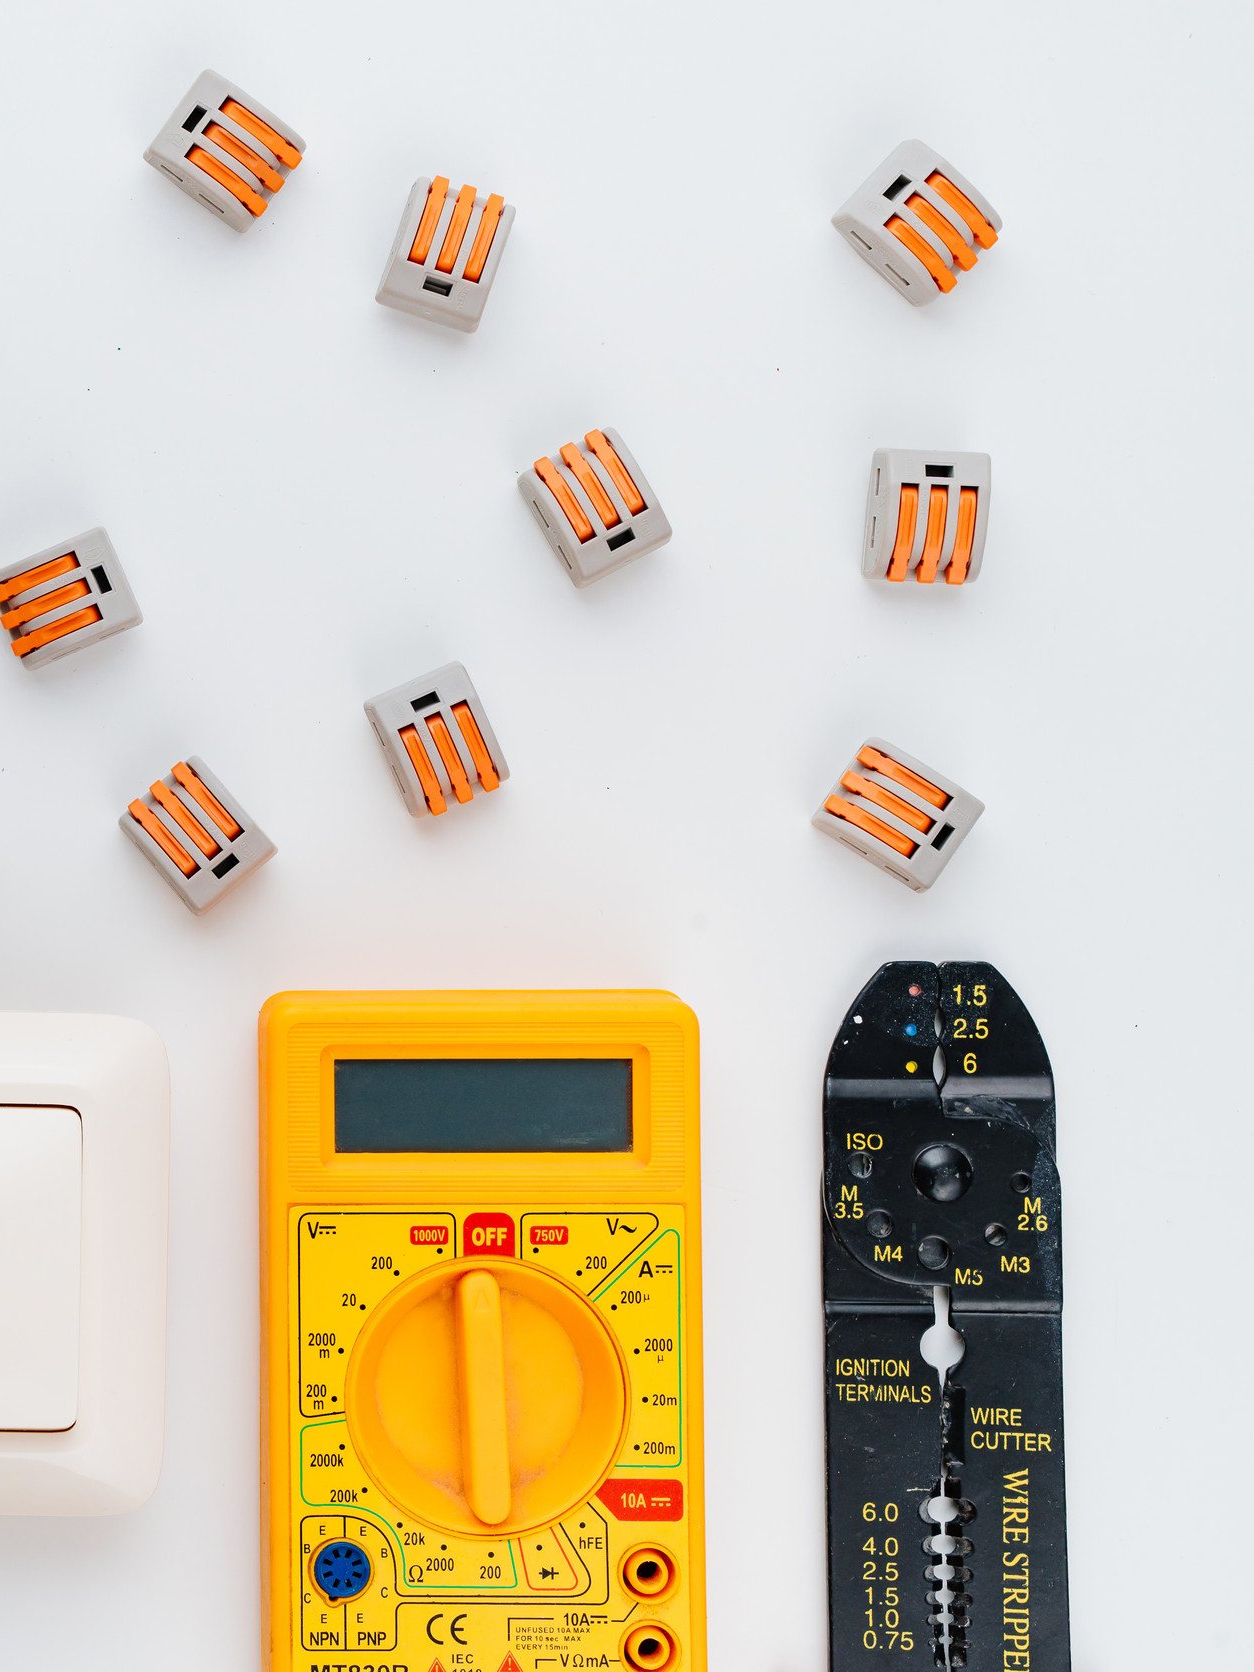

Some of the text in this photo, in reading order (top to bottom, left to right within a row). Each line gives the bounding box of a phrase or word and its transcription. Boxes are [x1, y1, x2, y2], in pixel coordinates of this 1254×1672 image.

[953, 985, 986, 1007] 1.5
[954, 1018, 988, 1039] 2.5
[964, 1053, 977, 1073] 6
[847, 1133, 883, 1150] ISO
[841, 1185, 857, 1201] M
[835, 1202, 863, 1219] 3.5
[1025, 1197, 1041, 1214] M
[1018, 1214, 1048, 1231] 2.6
[414, 1229, 445, 1241] 1000V
[472, 1227, 507, 1246] OFF
[535, 1229, 564, 1241] 750V
[875, 1246, 902, 1262] M4
[372, 1257, 392, 1269] 200
[586, 1256, 607, 1269] 200
[1001, 1256, 1030, 1273] M3
[955, 1268, 983, 1285] M5
[342, 1294, 356, 1306] 20
[309, 1333, 335, 1346] 2000
[645, 1339, 672, 1351] 2000
[320, 1349, 329, 1358] m
[837, 1358, 909, 1378] IGNITION
[307, 1384, 326, 1397] 200
[836, 1384, 931, 1403] TERMINALS
[314, 1400, 323, 1409] m
[653, 1394, 677, 1406] 20m
[971, 1408, 1021, 1426] WIRE
[971, 1431, 1051, 1451] CUTTER
[644, 1442, 675, 1454] 200m
[310, 1454, 343, 1467] 2000k
[330, 1491, 357, 1503] 200k
[621, 1493, 646, 1508] 10A
[863, 1503, 898, 1522] 6.0
[320, 1526, 326, 1535] E
[360, 1527, 366, 1536] E
[404, 1532, 425, 1545] 20k
[580, 1537, 602, 1549] hFE
[304, 1544, 310, 1553] B
[381, 1548, 388, 1558] B
[863, 1537, 898, 1556] 4.0
[427, 1558, 454, 1571] 2000
[1003, 1468, 1029, 1672] WIRE STRIPPE
[480, 1566, 501, 1579] 200
[863, 1562, 898, 1581] 2.5
[304, 1593, 311, 1603] C
[381, 1587, 388, 1598] C
[865, 1587, 898, 1606] 1.5
[321, 1614, 327, 1623] E
[357, 1614, 363, 1623] E
[564, 1613, 589, 1626] 10A
[865, 1609, 899, 1628] 1.0
[427, 1614, 467, 1645] CE
[310, 1632, 339, 1646] NPN
[358, 1632, 386, 1645] PNP
[863, 1630, 913, 1650] 0.75
[452, 1654, 473, 1663] IEC
